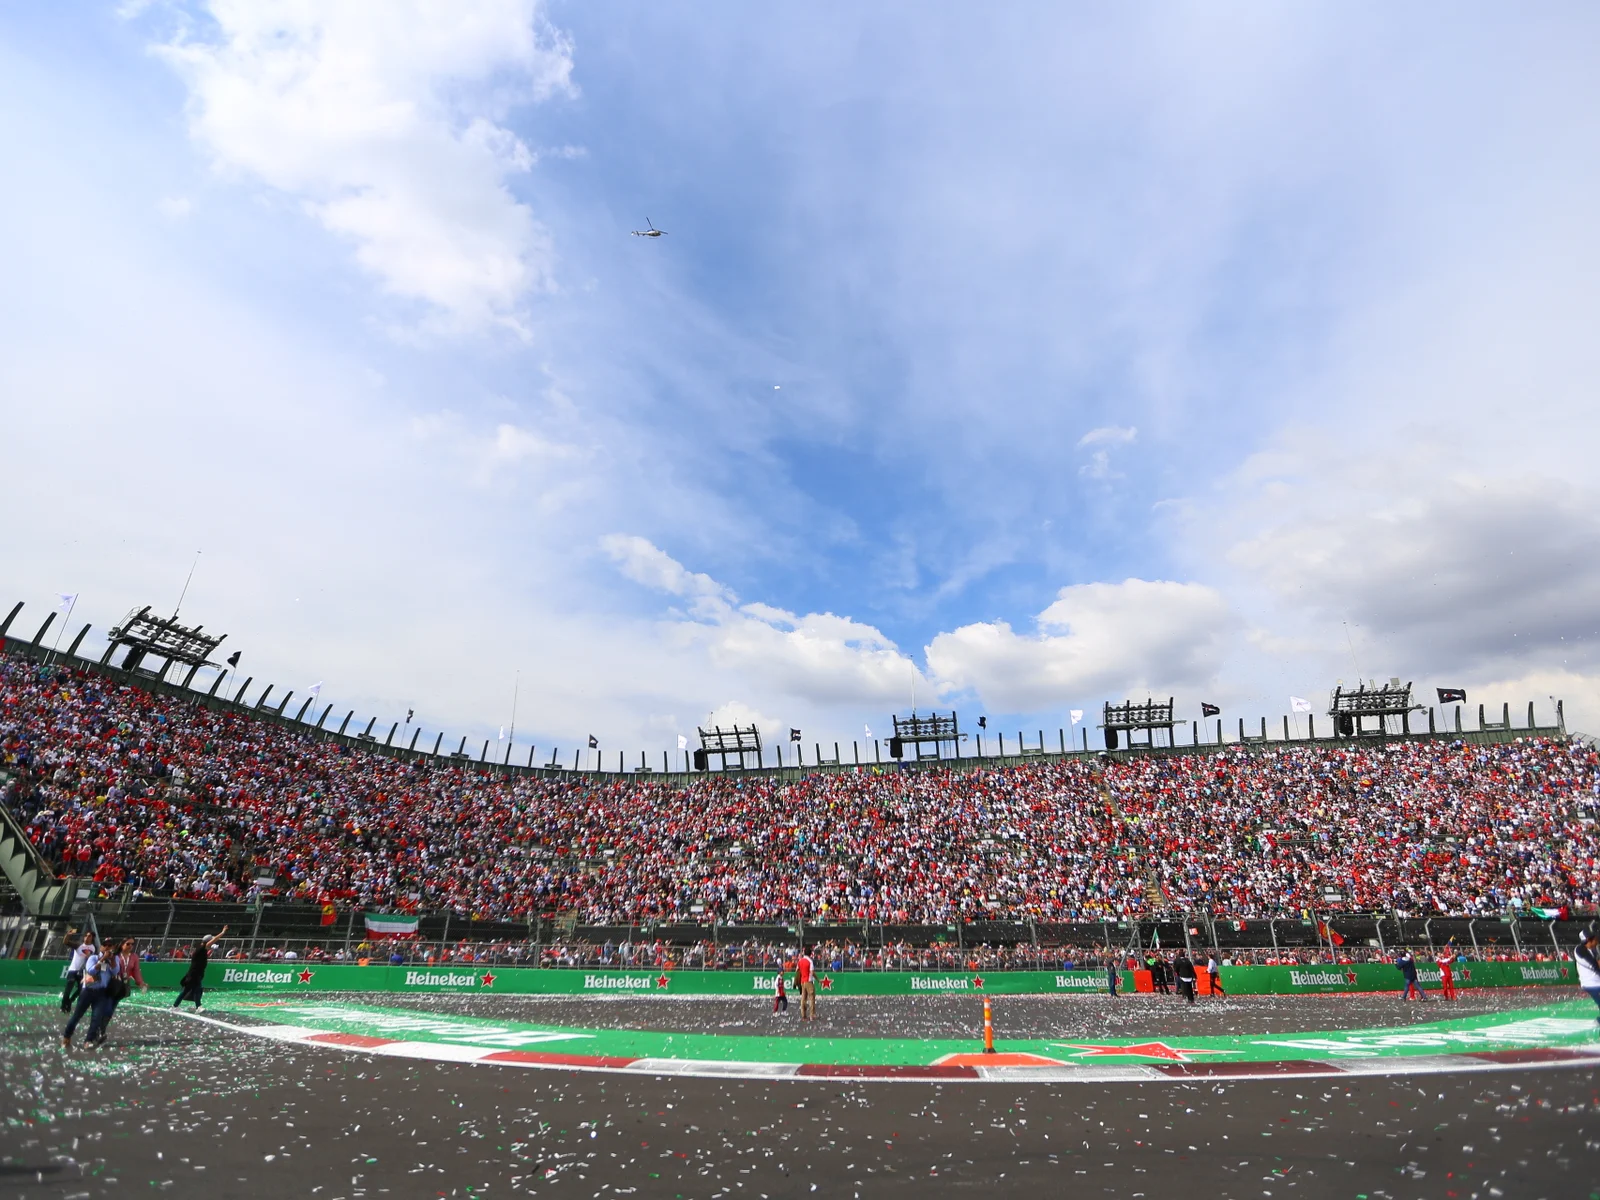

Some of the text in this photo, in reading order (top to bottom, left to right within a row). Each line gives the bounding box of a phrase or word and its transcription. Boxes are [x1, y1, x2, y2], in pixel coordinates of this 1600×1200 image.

[223, 969, 292, 983] Heineken
[405, 971, 475, 986] Heineken
[583, 974, 651, 988] Heineken
[1055, 975, 1109, 987] Heineken
[1290, 970, 1345, 985] Heineken
[1415, 968, 1460, 982] Heineen
[911, 976, 968, 989] Heineken
